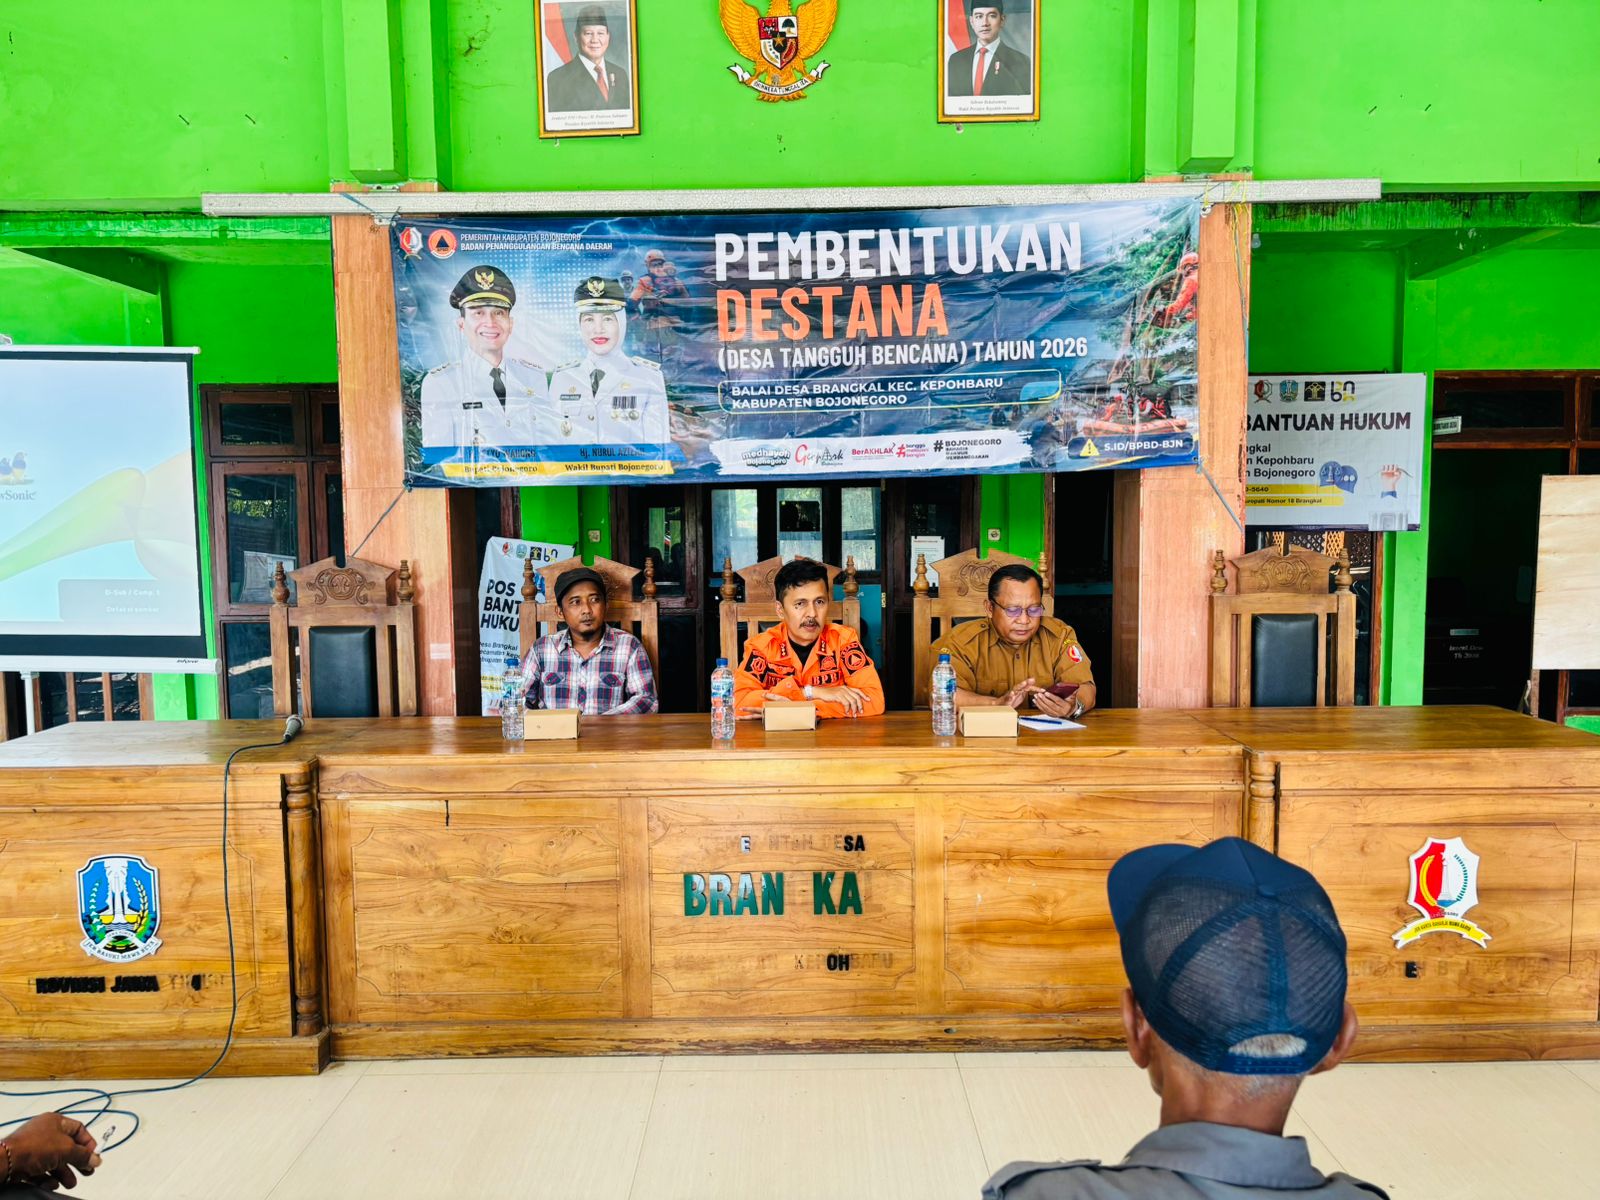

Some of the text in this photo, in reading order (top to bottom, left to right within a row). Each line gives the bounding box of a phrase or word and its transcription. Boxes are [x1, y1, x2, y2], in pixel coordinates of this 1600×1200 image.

[461, 233, 581, 242] PEMERINTAH KABUPATEN BOJONEGORO
[461, 242, 613, 251] BADAN PENANGGULANGAN BENCANA DAERAH
[715, 222, 1082, 282] PEMBENTUKAN
[717, 283, 949, 342] DESTANA
[718, 337, 1087, 371] (DESA TANGGUH BENCANA) TAHUN 2026
[732, 378, 1004, 396] BALAI DESA BRANGKAL KEC. KEPOHBARU
[732, 395, 907, 409] KABUPATEN BOJONEGORO
[1340, 412, 1411, 431] HUKUM
[592, 448, 616, 457] NURUL
[851, 447, 894, 456] BerAKHLAK
[1104, 439, 1183, 452] S.ID/BPBD-BJN
[565, 463, 664, 473] Wakil Bupati Bojonegoro
[1256, 456, 1314, 467] Kepohbaru
[1254, 468, 1316, 480] Bojonegoro
[486, 579, 516, 597] POS
[483, 596, 521, 614] BANT
[481, 614, 520, 632] HUKU
